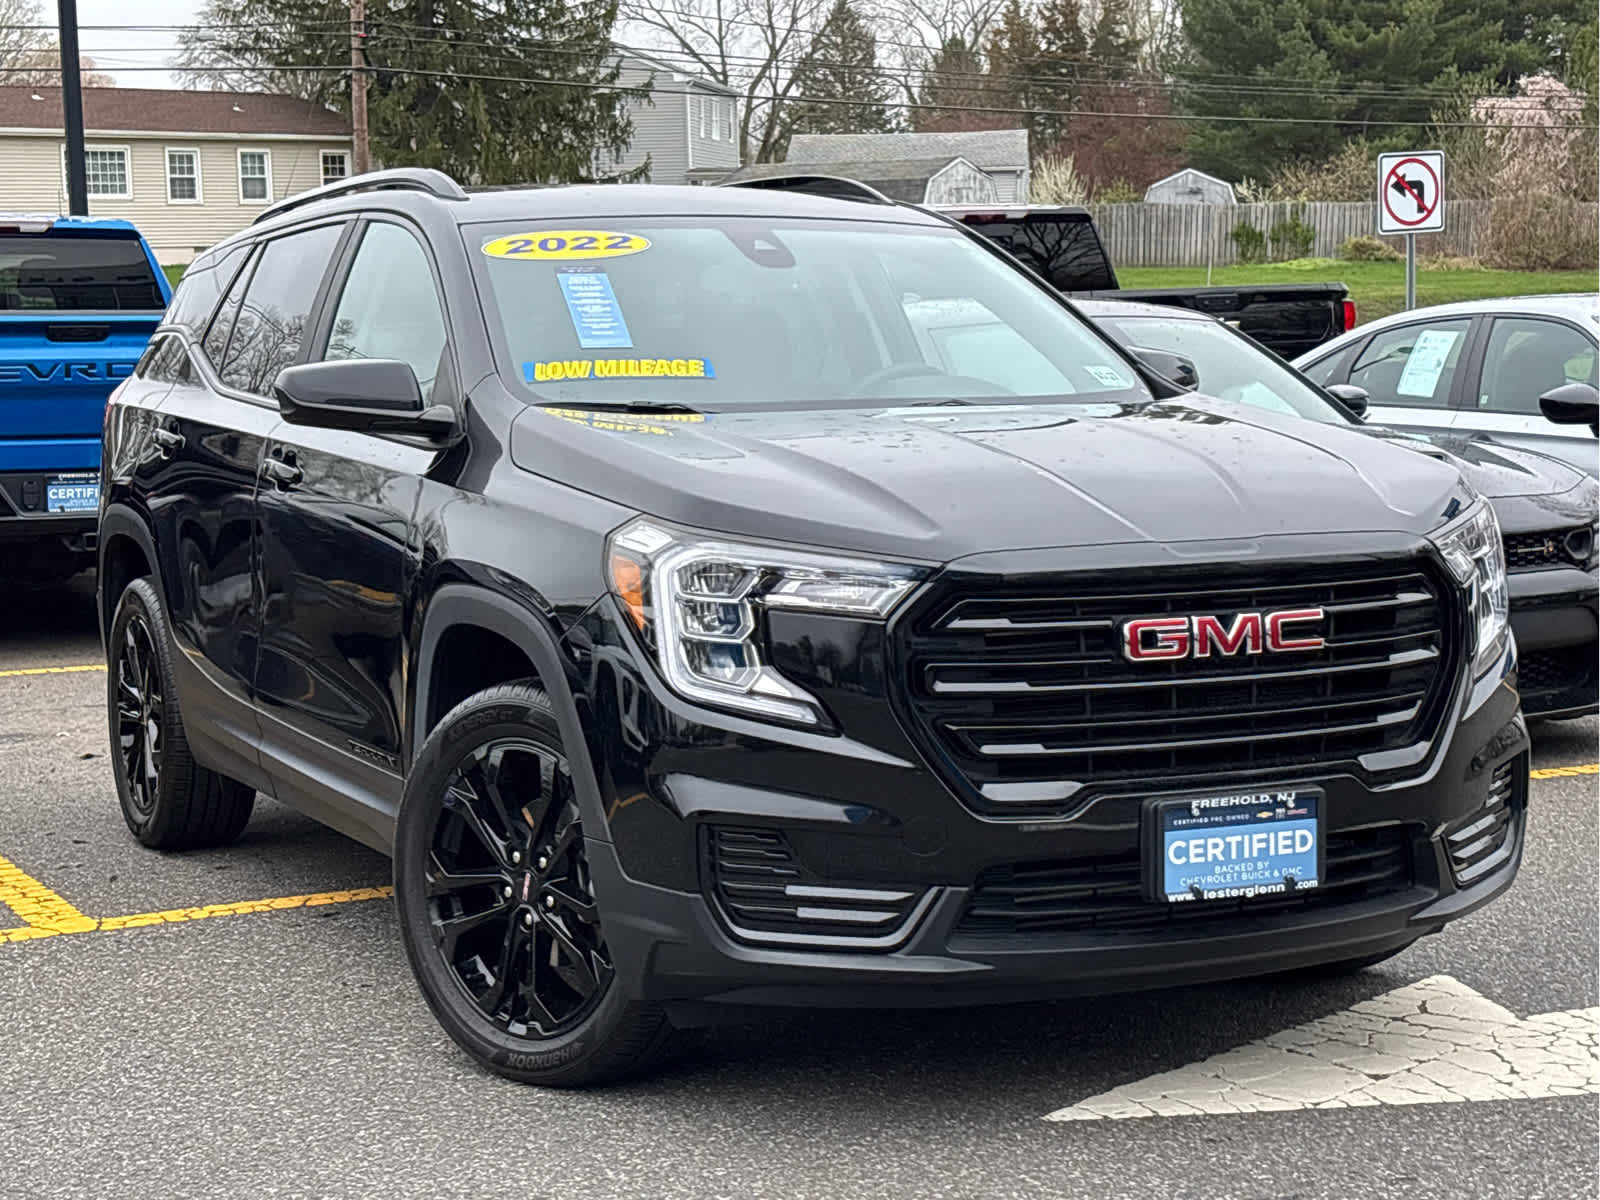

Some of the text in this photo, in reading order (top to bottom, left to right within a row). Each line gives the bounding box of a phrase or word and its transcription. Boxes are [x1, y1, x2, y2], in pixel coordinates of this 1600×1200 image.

[505, 236, 633, 254] 2022
[534, 358, 705, 381] LOW MILEAGE
[1123, 608, 1325, 661] GMC
[1191, 791, 1296, 809] FREEHOLD, NJ
[1173, 817, 1209, 826] CERTIFIED
[1168, 829, 1313, 865] CERTIFIED
[1214, 861, 1270, 874] BACKED BY
[1179, 866, 1303, 888] CHEVROLET BUICK & GMC
[1203, 883, 1285, 900] lesterglenn
